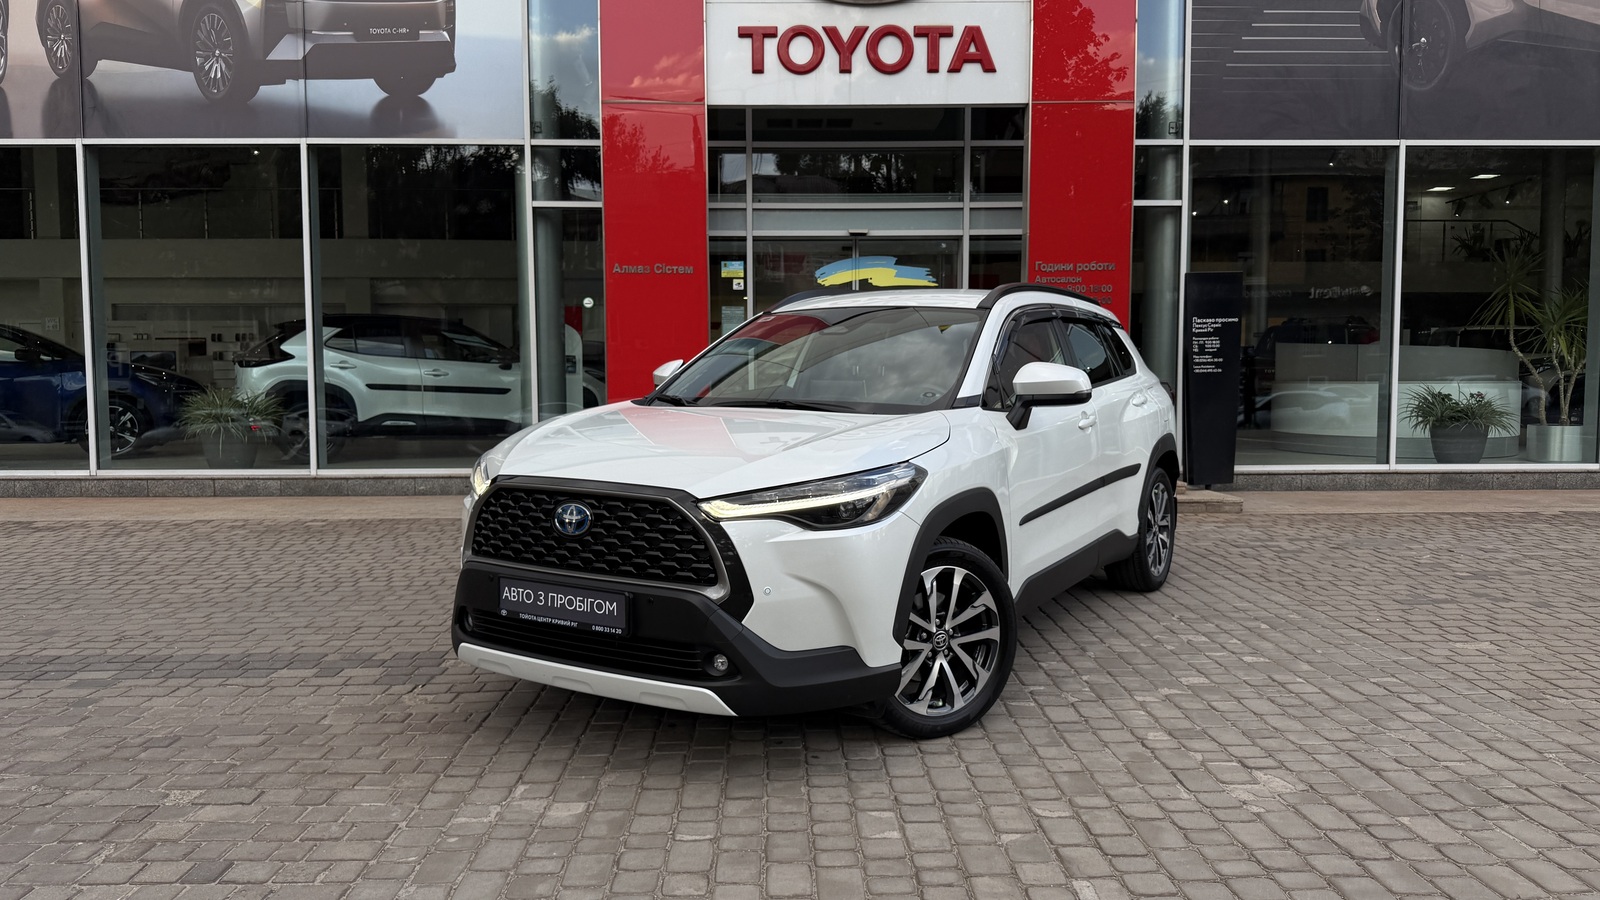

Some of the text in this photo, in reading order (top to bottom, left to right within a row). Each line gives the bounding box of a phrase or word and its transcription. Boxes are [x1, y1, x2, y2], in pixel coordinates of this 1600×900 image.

[738, 24, 997, 75] TOYOTA
[612, 263, 694, 274] Алмаз Сістем
[1035, 261, 1115, 273] Години роботи
[1035, 275, 1082, 283] Автосалон
[502, 586, 534, 604] АВТО
[548, 592, 617, 616] ПРОБІГОМ
[519, 613, 538, 621] ТОЙОТА
[536, 616, 552, 624] ЦЕНТР
[551, 618, 571, 626] КРИВИЙ
